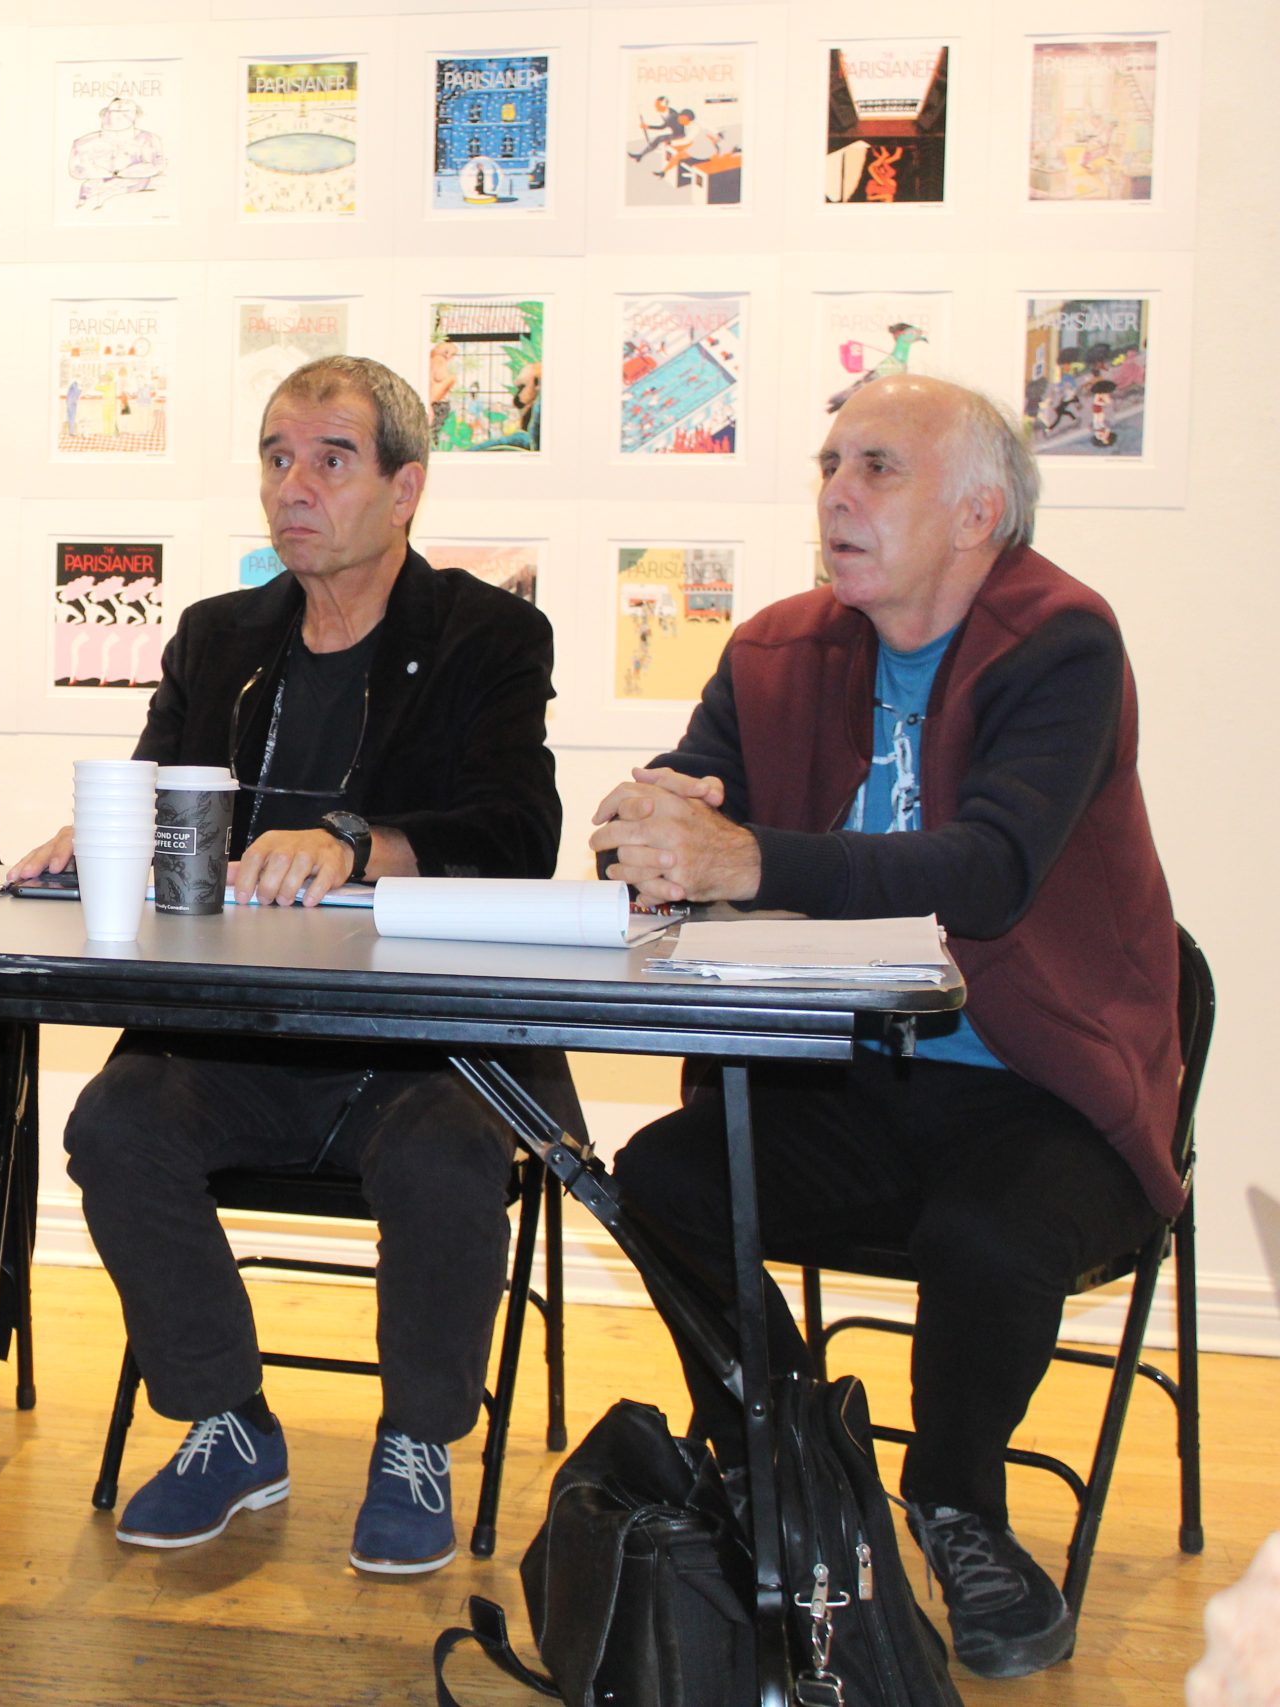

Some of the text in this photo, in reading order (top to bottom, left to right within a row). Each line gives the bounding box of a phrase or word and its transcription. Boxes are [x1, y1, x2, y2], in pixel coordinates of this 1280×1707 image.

[444, 69, 539, 90] PARISIANER
[636, 64, 734, 84] PARISIANER
[72, 79, 163, 99] PARISIANER
[255, 74, 348, 95] PARISIANER
[69, 318, 158, 336] PARISIANER
[247, 316, 339, 335] PARISIANER
[64, 554, 155, 574] PARISIANER
[157, 832, 190, 841] OND CUP
[157, 840, 187, 849] FFEE CO.
